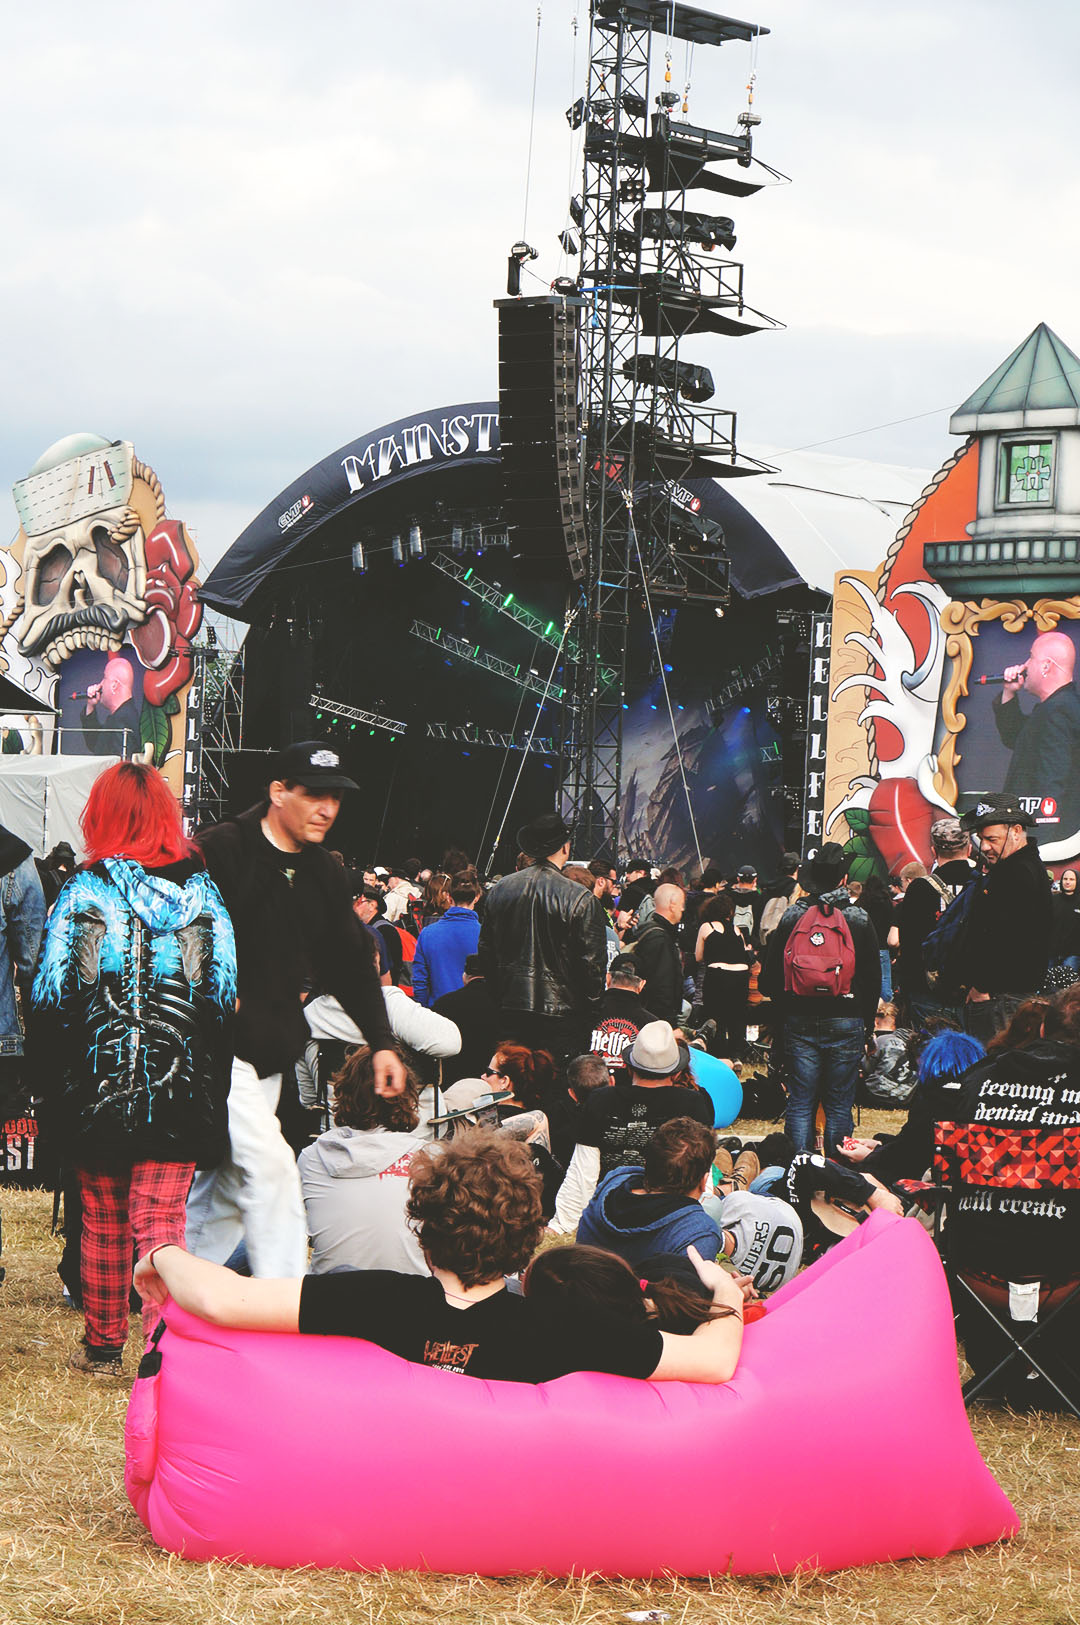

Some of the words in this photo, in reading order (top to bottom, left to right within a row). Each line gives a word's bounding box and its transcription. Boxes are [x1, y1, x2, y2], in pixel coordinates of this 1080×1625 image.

[341, 414, 500, 494] MAINST
[974, 1102, 1040, 1123] denial
[958, 1189, 994, 1212] will
[998, 1198, 1067, 1220] create
